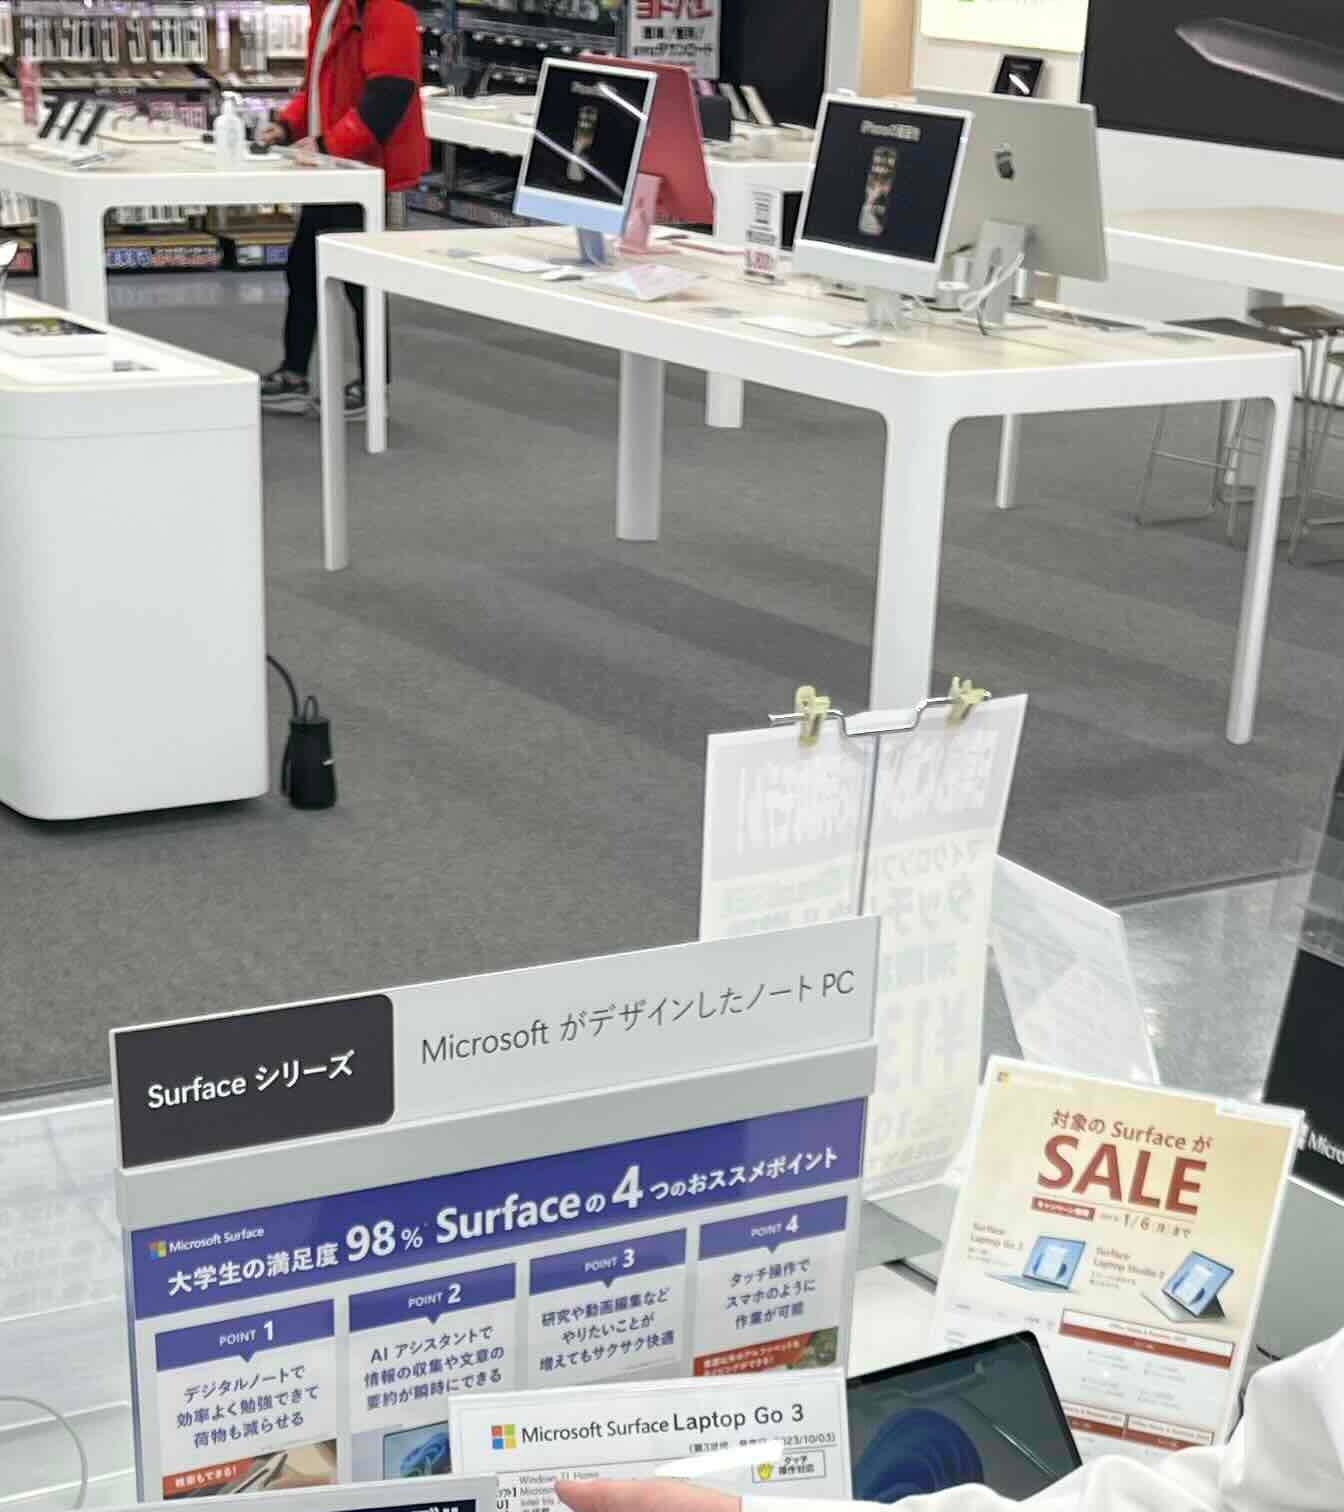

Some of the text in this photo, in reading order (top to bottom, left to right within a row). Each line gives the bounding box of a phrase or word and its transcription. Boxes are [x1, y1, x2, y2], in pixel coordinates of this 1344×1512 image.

[422, 969, 855, 1065] Microsoft がデザインしたノート PC
[147, 1050, 355, 1109] Surface シリーズ
[1111, 1120, 1186, 1150] Surface
[1192, 1135, 1214, 1154] が
[1037, 1134, 1208, 1216] SALE
[169, 1226, 264, 1254] Microsoft Surface
[751, 1214, 799, 1238] POINT 4
[167, 1242, 339, 1296] 大学生の満足度
[585, 1248, 635, 1272] POINT 3
[730, 1259, 810, 1288] タッチ操作で
[408, 1283, 461, 1308] POINT 2
[541, 1287, 671, 1327] 研究や動画編集など
[726, 1280, 815, 1309] スマホのように
[219, 1320, 274, 1346] POINT 1
[562, 1312, 655, 1345] やりたいことが
[735, 1301, 804, 1330] 作業が可能
[371, 1325, 493, 1364] AI アシスタントで
[540, 1329, 675, 1371] 増えてもサクサク快適
[184, 1365, 305, 1402] デジタルノートで
[365, 1346, 505, 1388] 情報の収集や文章の
[177, 1385, 320, 1428] 効率よく勉強できて
[367, 1368, 502, 1411] 要約が瞬時にできる
[194, 1411, 304, 1448] 荷物も減らせる
[522, 1403, 805, 1444] Microsoft Surface Laptop Go 3
